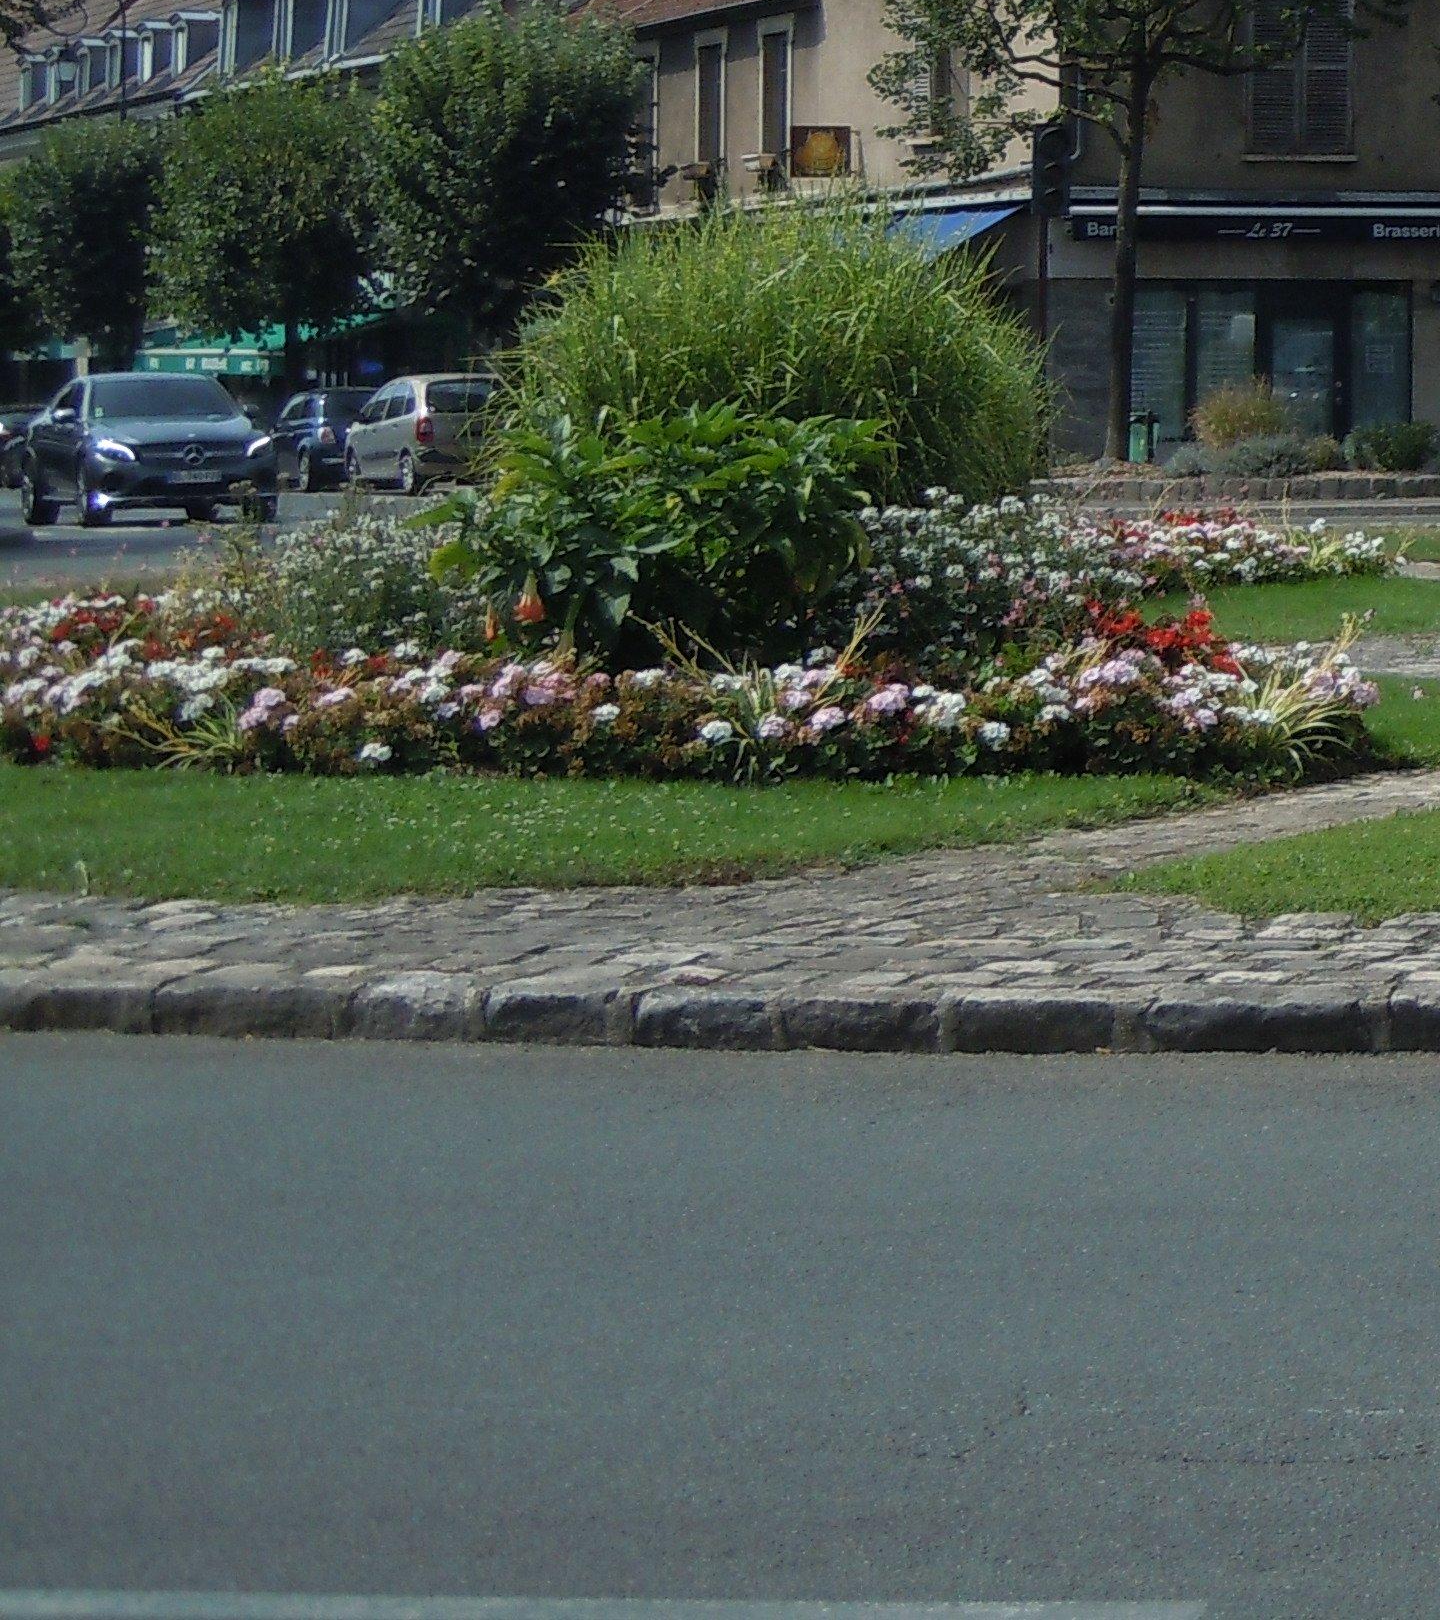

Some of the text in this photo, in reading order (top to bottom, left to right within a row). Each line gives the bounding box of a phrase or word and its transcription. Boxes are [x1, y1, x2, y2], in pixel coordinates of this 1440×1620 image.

[1087, 221, 1119, 236] Bar
[1246, 222, 1294, 238] Le 37
